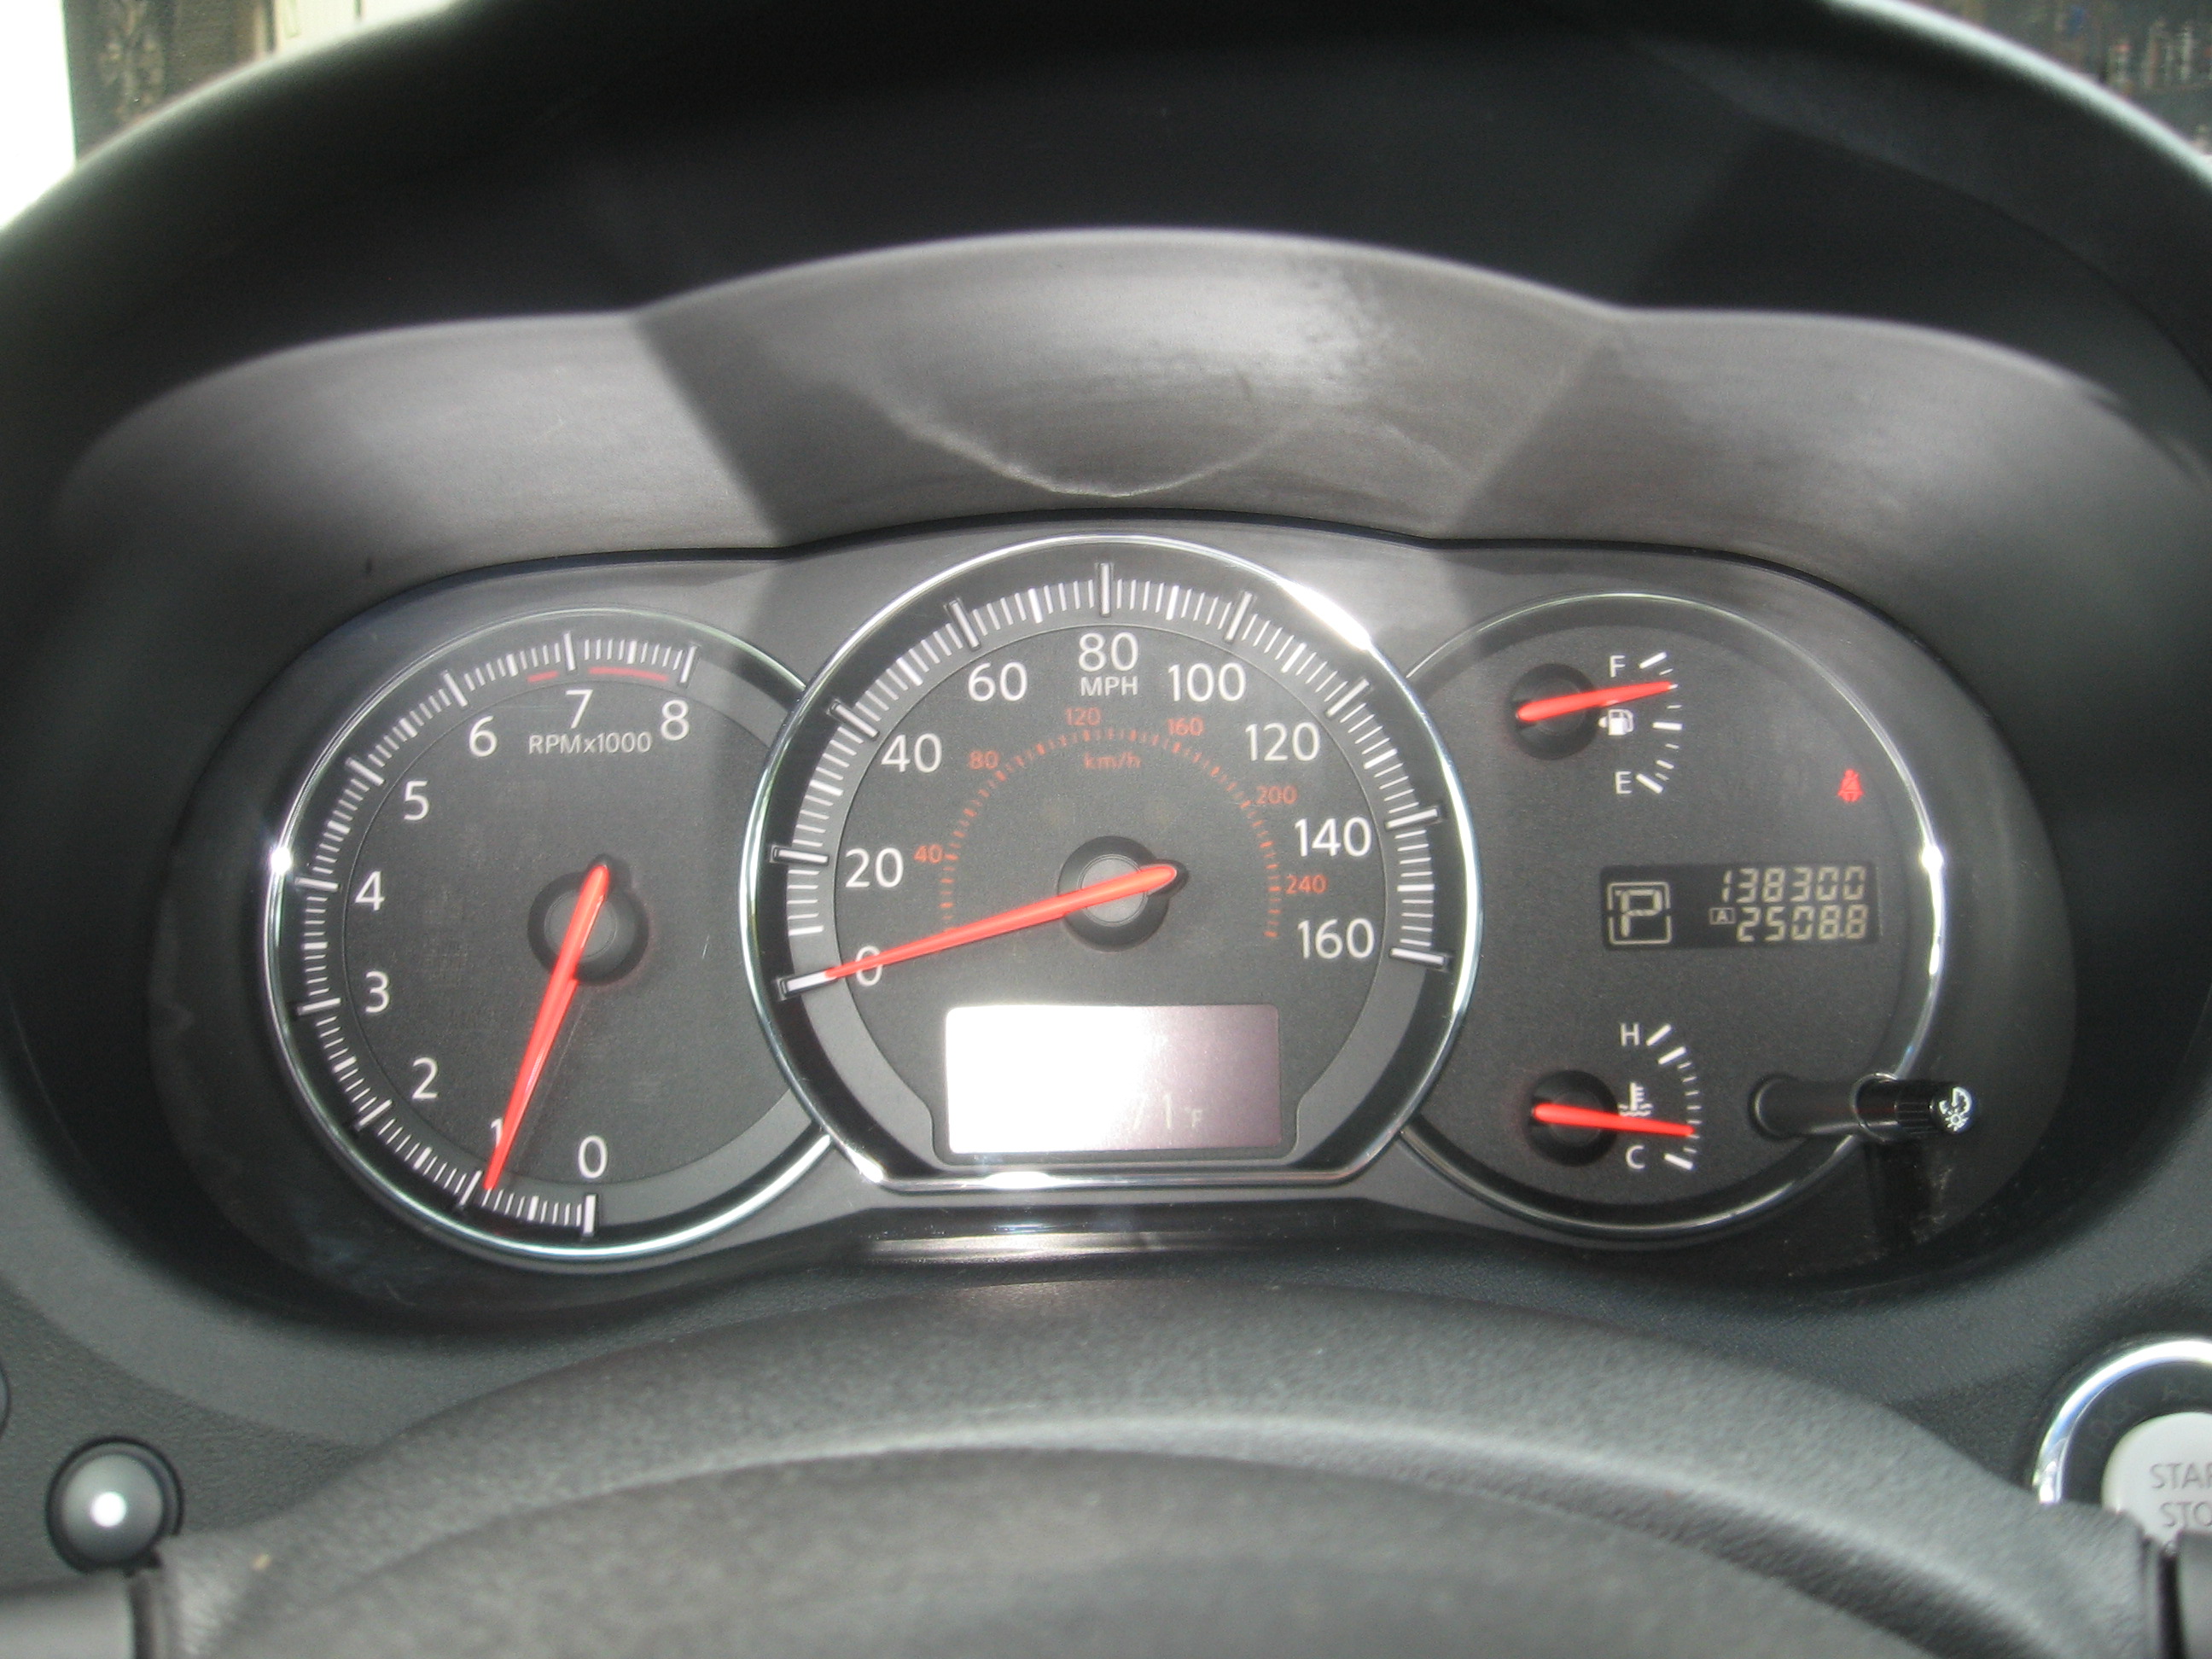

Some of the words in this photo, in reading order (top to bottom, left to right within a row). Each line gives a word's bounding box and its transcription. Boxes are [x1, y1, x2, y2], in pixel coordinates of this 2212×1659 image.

[1079, 632, 1138, 671] 80
[1610, 655, 1625, 677] F
[969, 662, 1027, 701] 60
[1080, 676, 1138, 696] MPH
[1169, 662, 1246, 701] 100
[566, 689, 592, 728] 7
[661, 700, 689, 740] 8
[1065, 707, 1101, 726] 120
[1168, 718, 1203, 736] 160
[469, 716, 496, 756] 6
[882, 733, 941, 772] 40
[1246, 722, 1319, 760] 120
[969, 750, 999, 770] 80
[1084, 752, 1140, 768] km/h
[405, 781, 428, 820] 5
[1256, 786, 1297, 804] 200
[1616, 771, 1631, 794] E
[913, 845, 942, 864] 40
[1295, 817, 1371, 856] 140
[846, 847, 903, 888] 20
[1287, 875, 1327, 894] 240
[1720, 866, 1866, 903] 138300
[355, 871, 384, 911] 4
[1615, 888, 1662, 937] P
[1299, 918, 1374, 958] 160
[855, 945, 882, 987] 0
[366, 971, 388, 1013] 3
[1621, 1024, 1639, 1045] H
[412, 1057, 437, 1100] 2
[579, 1136, 607, 1179] 0
[1627, 1145, 1644, 1169] C
